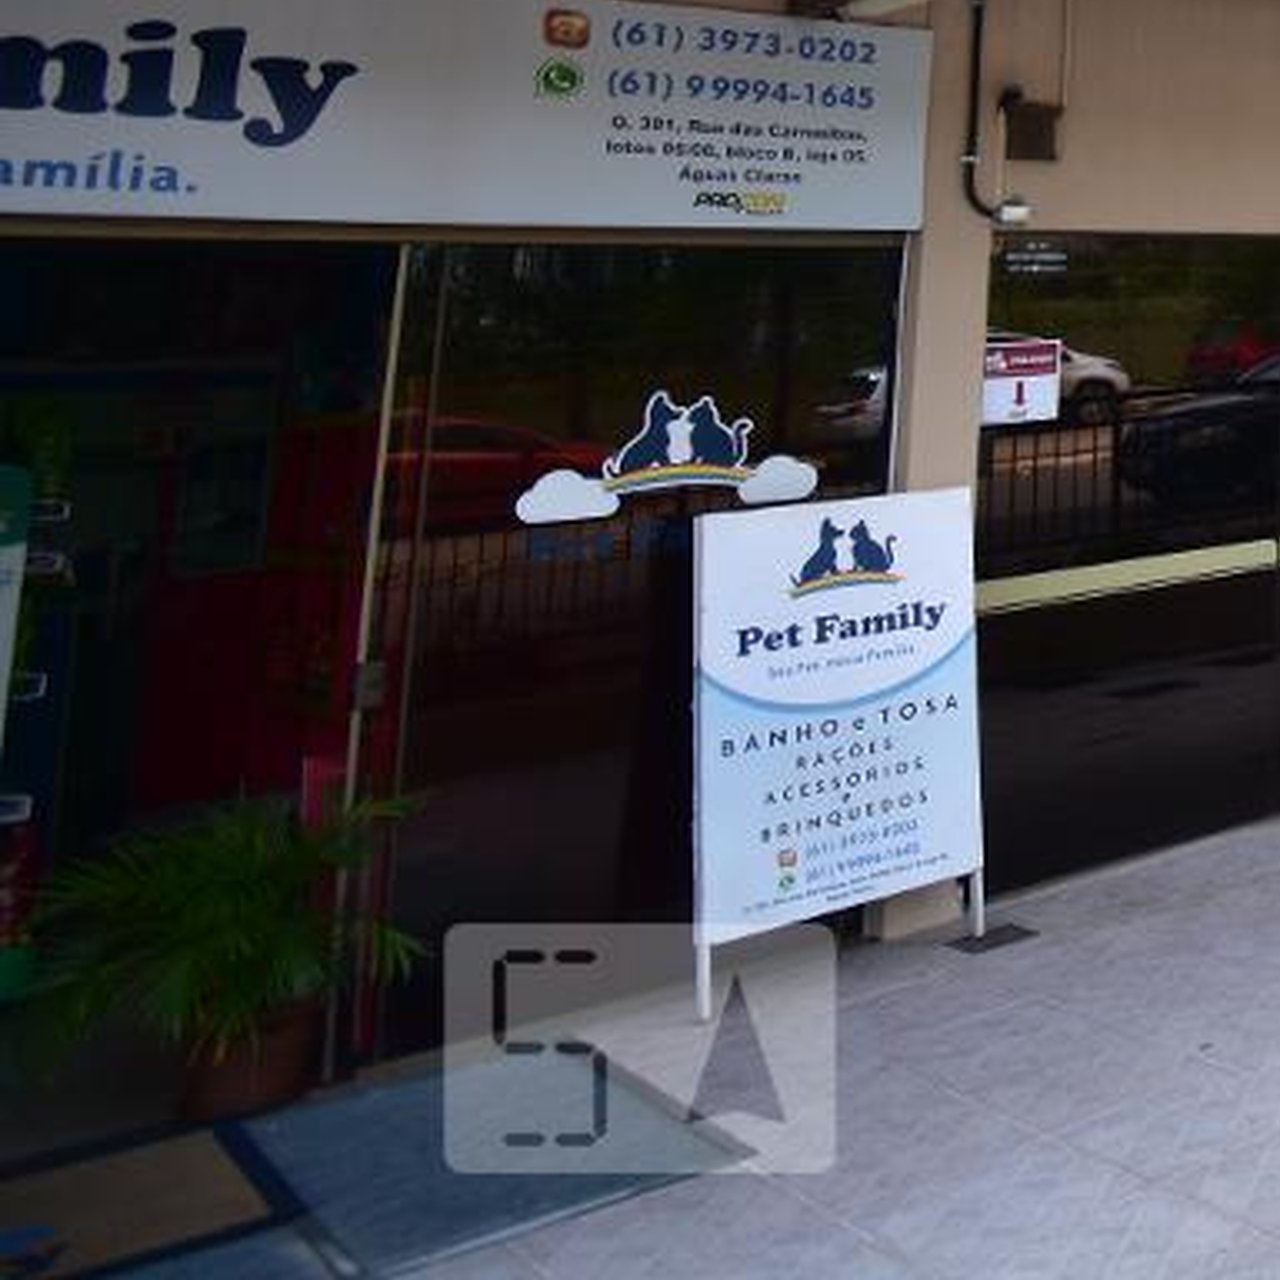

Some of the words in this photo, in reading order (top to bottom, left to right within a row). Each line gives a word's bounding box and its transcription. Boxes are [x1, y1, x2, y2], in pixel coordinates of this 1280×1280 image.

[611, 19, 686, 54] (61)
[697, 26, 878, 65] 3973-0202
[607, 69, 674, 102] (61)
[735, 620, 803, 658] Pet
[812, 600, 947, 645] Family
[720, 718, 840, 759] BANHO
[878, 692, 959, 725] TOSA
[795, 736, 895, 770] RAÇÕES
[759, 788, 928, 844] BRINQUEDOS
